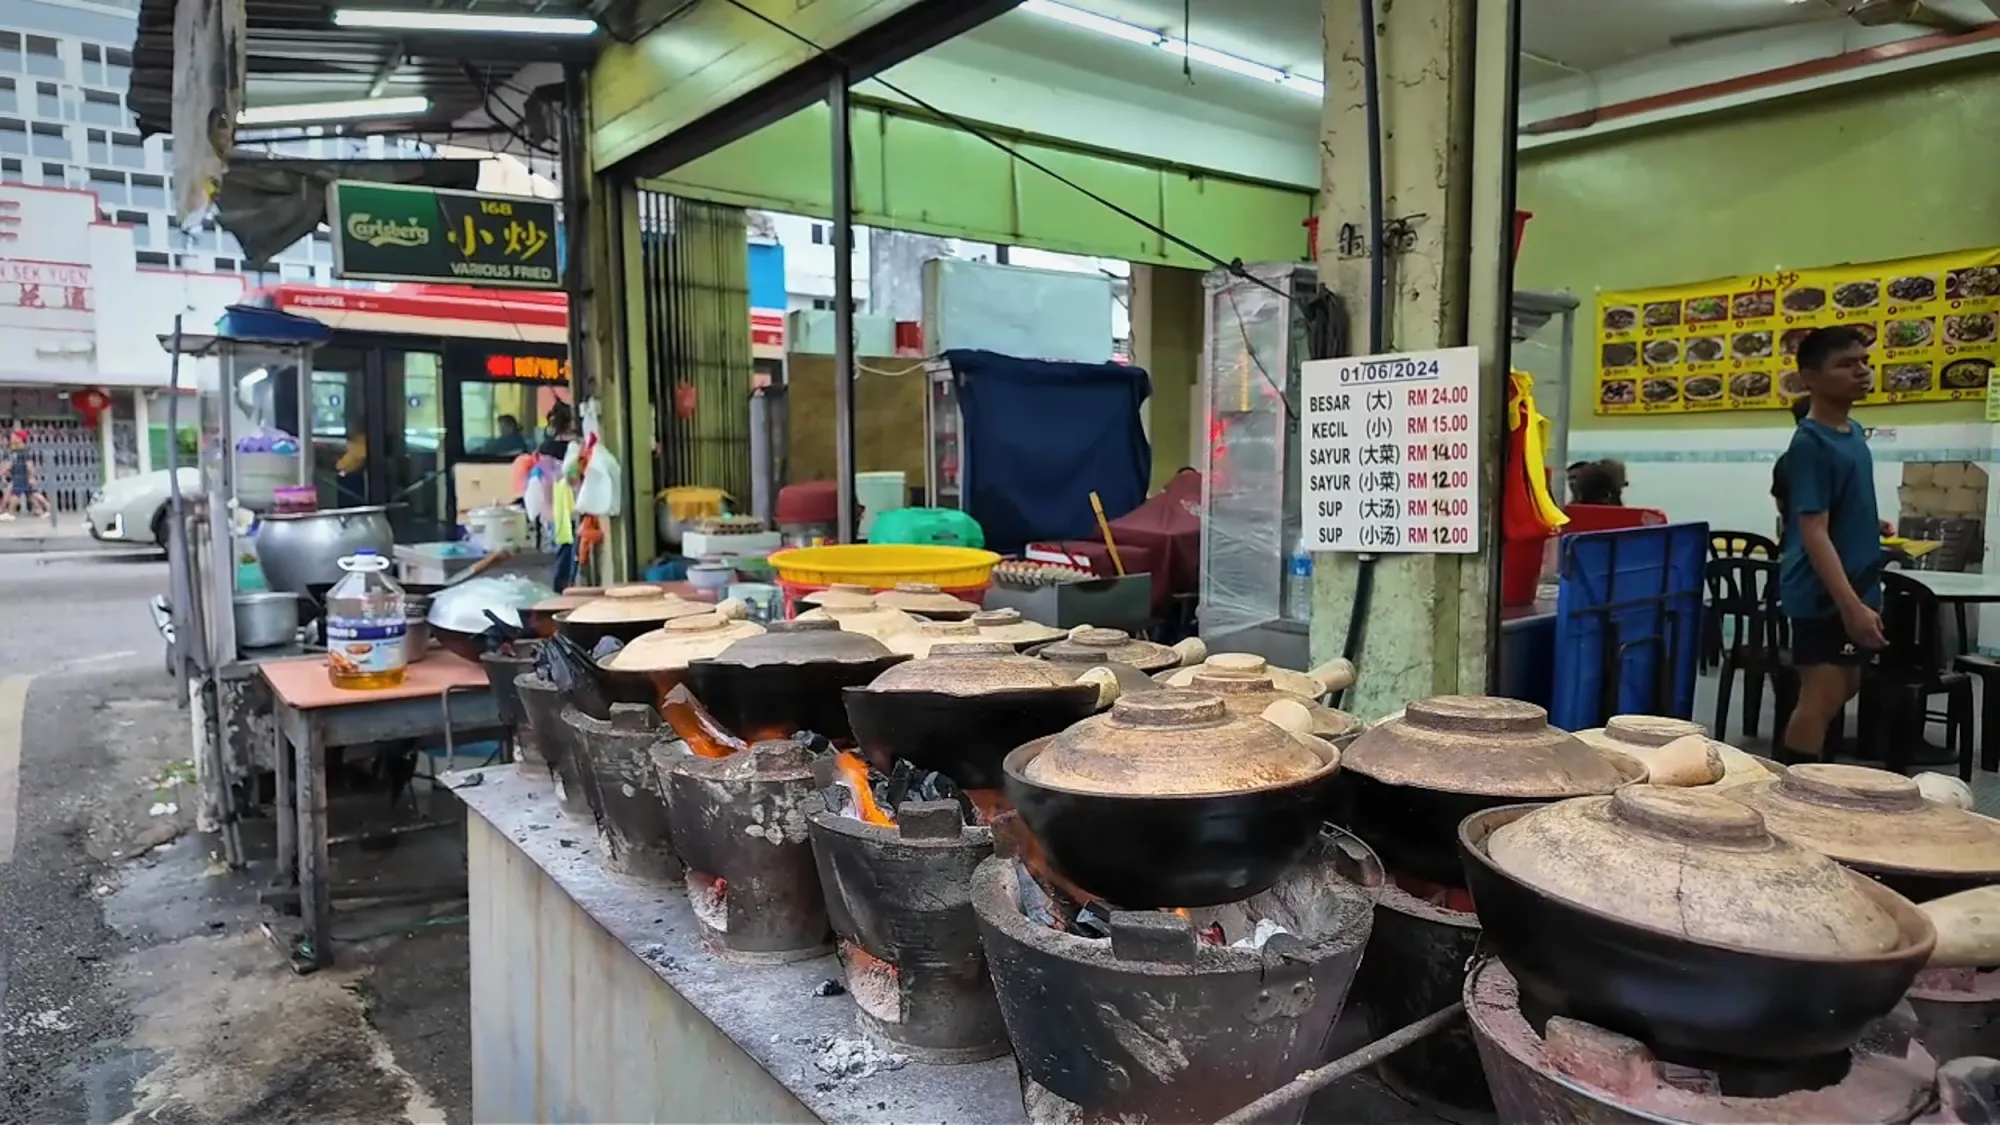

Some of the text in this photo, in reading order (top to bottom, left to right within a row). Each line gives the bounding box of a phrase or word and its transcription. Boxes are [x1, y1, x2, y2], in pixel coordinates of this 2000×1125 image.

[480, 200, 513, 216] 168
[347, 212, 430, 248] Carlsberg
[447, 214, 548, 261] 小炒
[450, 262, 553, 280] VARIOUS FRIED
[1750, 271, 1799, 291] 小炒
[1340, 360, 1439, 382] 01/06/2024
[1310, 385, 1468, 413] BESAR (大) RM 24.00
[1312, 414, 1468, 439] KECIL (小) RM 15.00
[1310, 442, 1468, 466] SAYUR (大菜) RM 14.00
[1310, 470, 1468, 493] SAYUR (小菜) RM 12.00
[1318, 498, 1468, 520] SUP (大汤) RM 14.00
[1318, 525, 1468, 547] SUP (小汤) RM 12.00
